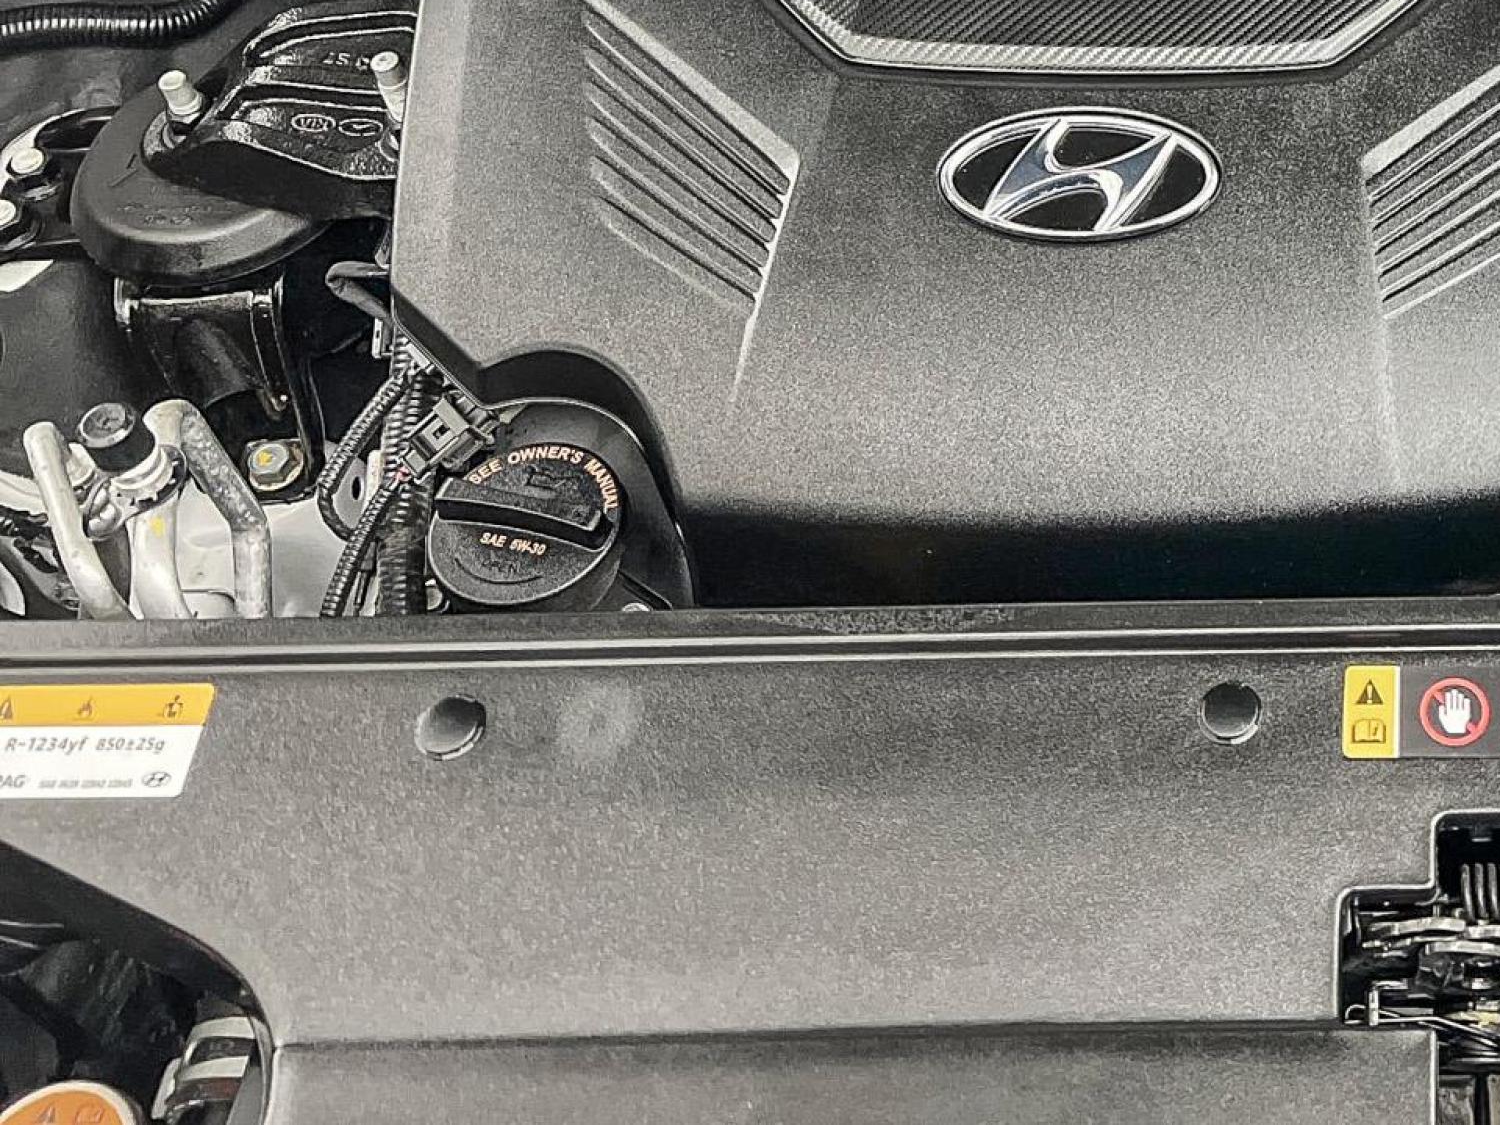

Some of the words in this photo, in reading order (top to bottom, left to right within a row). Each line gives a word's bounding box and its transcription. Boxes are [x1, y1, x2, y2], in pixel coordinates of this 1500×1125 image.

[468, 458, 503, 485] SEE
[507, 445, 584, 465] OWNER'S
[583, 458, 619, 515] MANUAL
[480, 532, 508, 548] SAE
